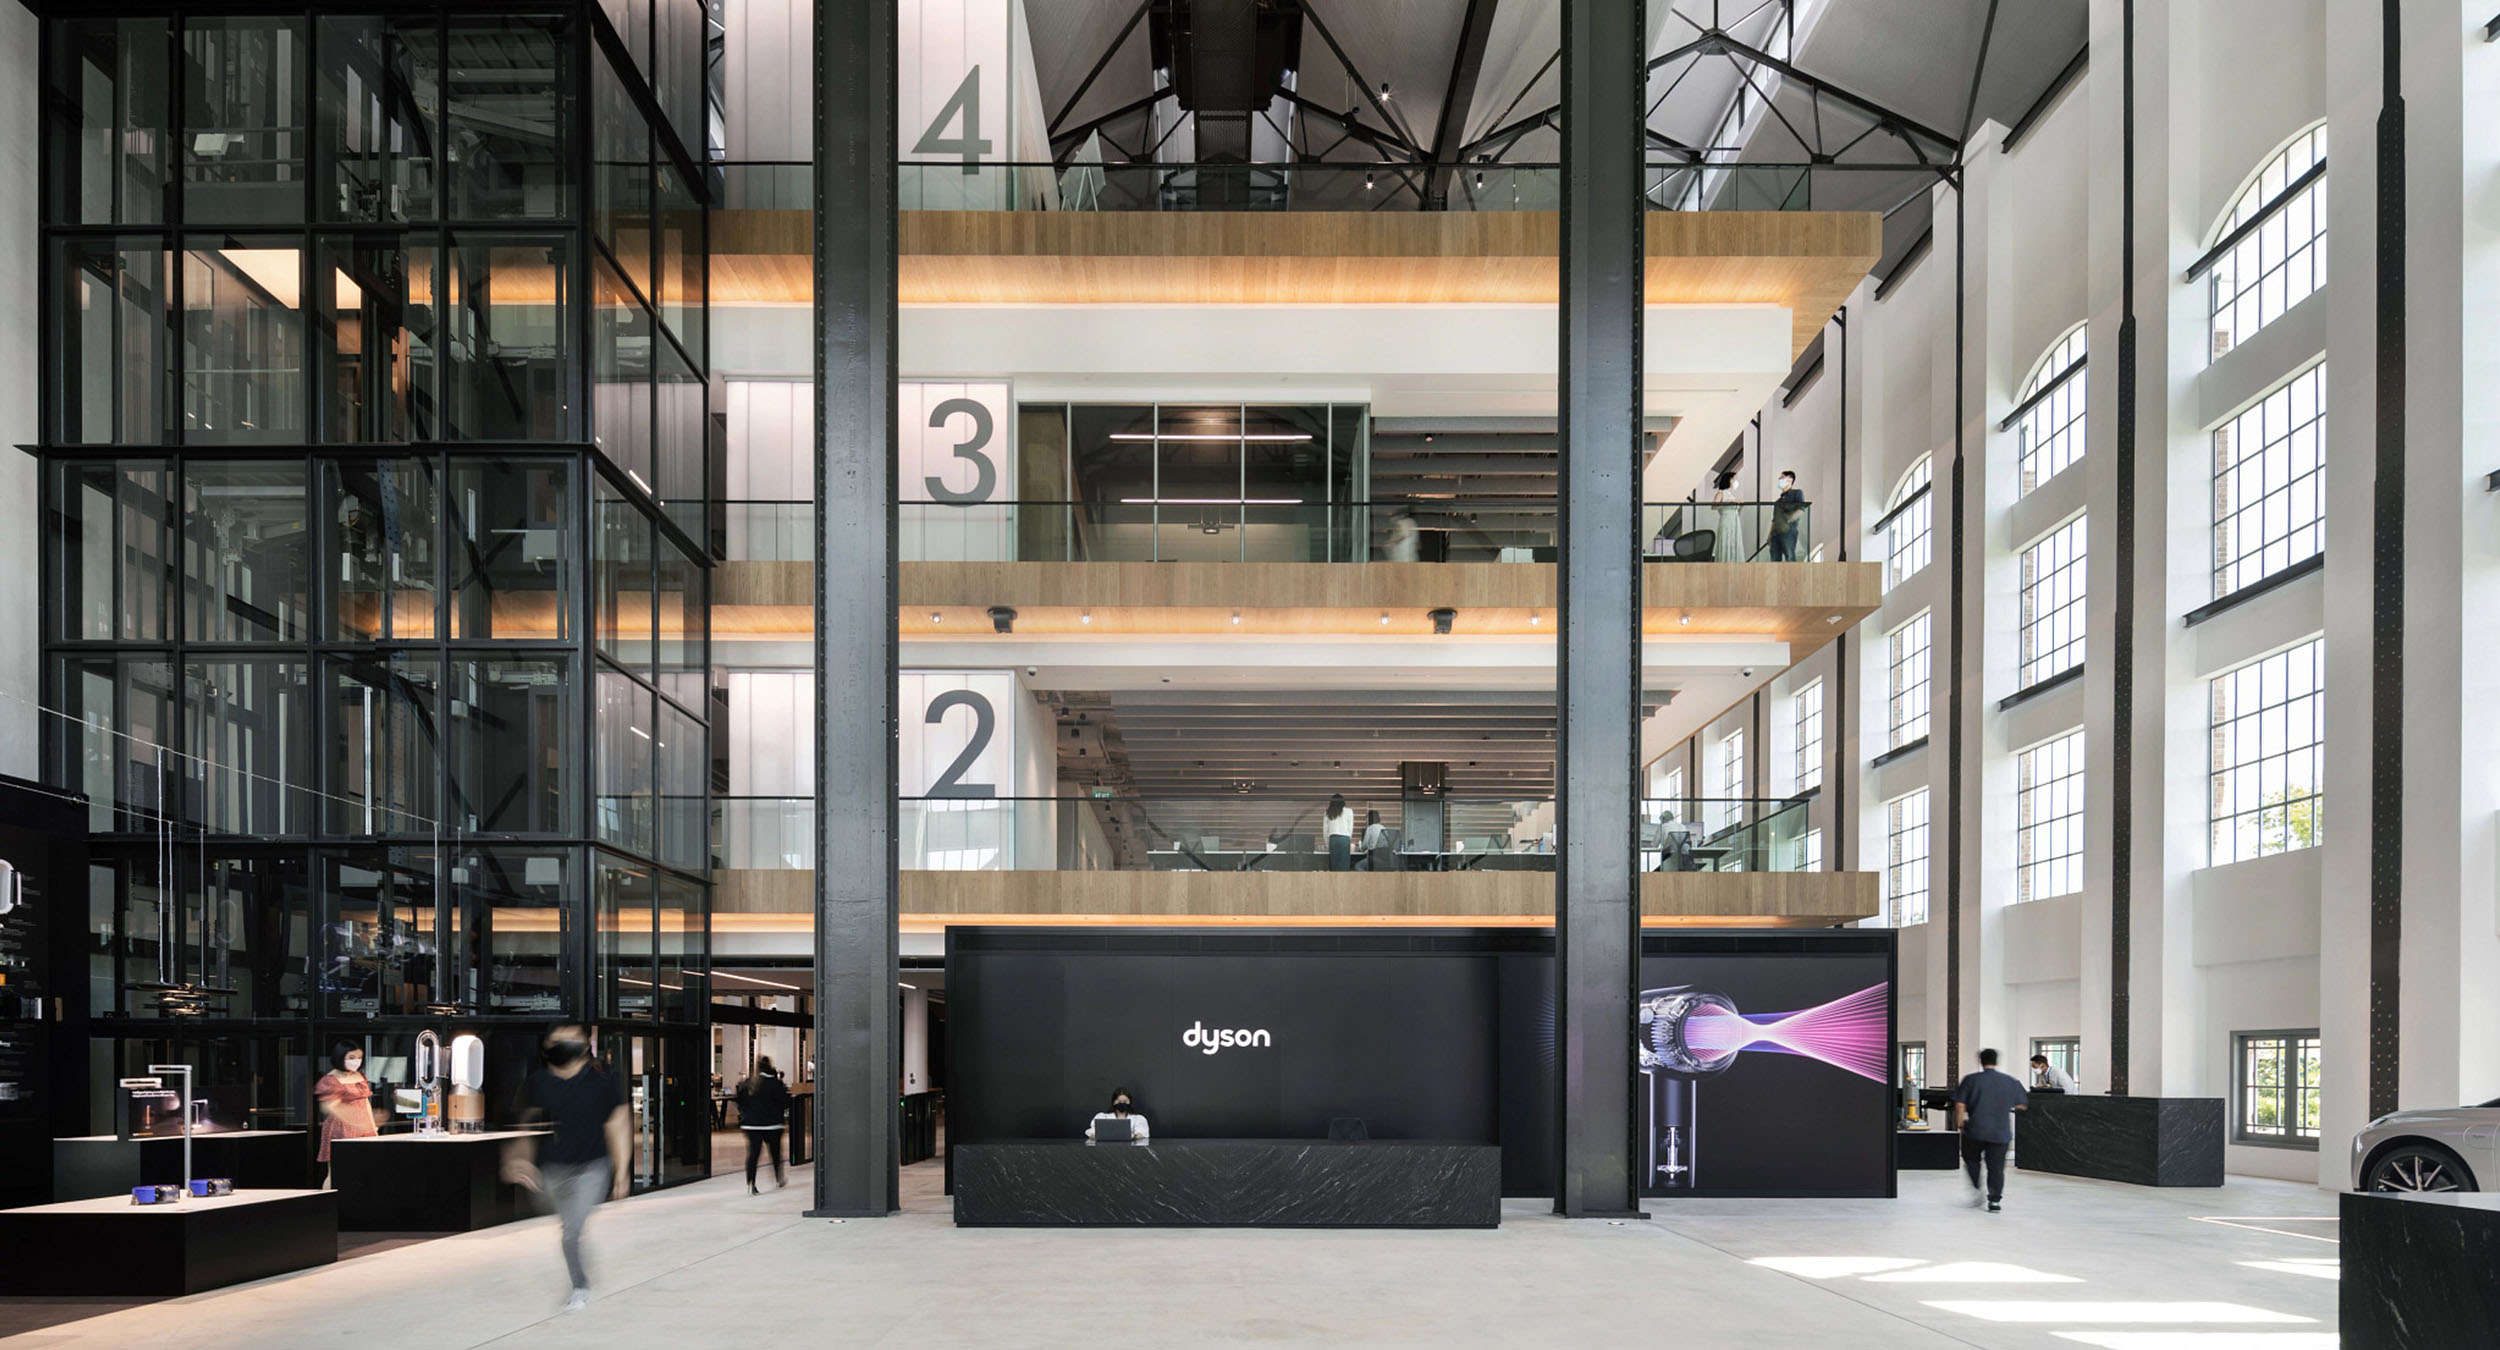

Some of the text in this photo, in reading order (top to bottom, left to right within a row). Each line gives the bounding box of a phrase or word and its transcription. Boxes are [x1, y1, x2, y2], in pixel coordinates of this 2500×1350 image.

[910, 64, 993, 175] 4
[924, 398, 996, 508] 3
[923, 689, 996, 798] 2
[1182, 1020, 1271, 1055] dyson
